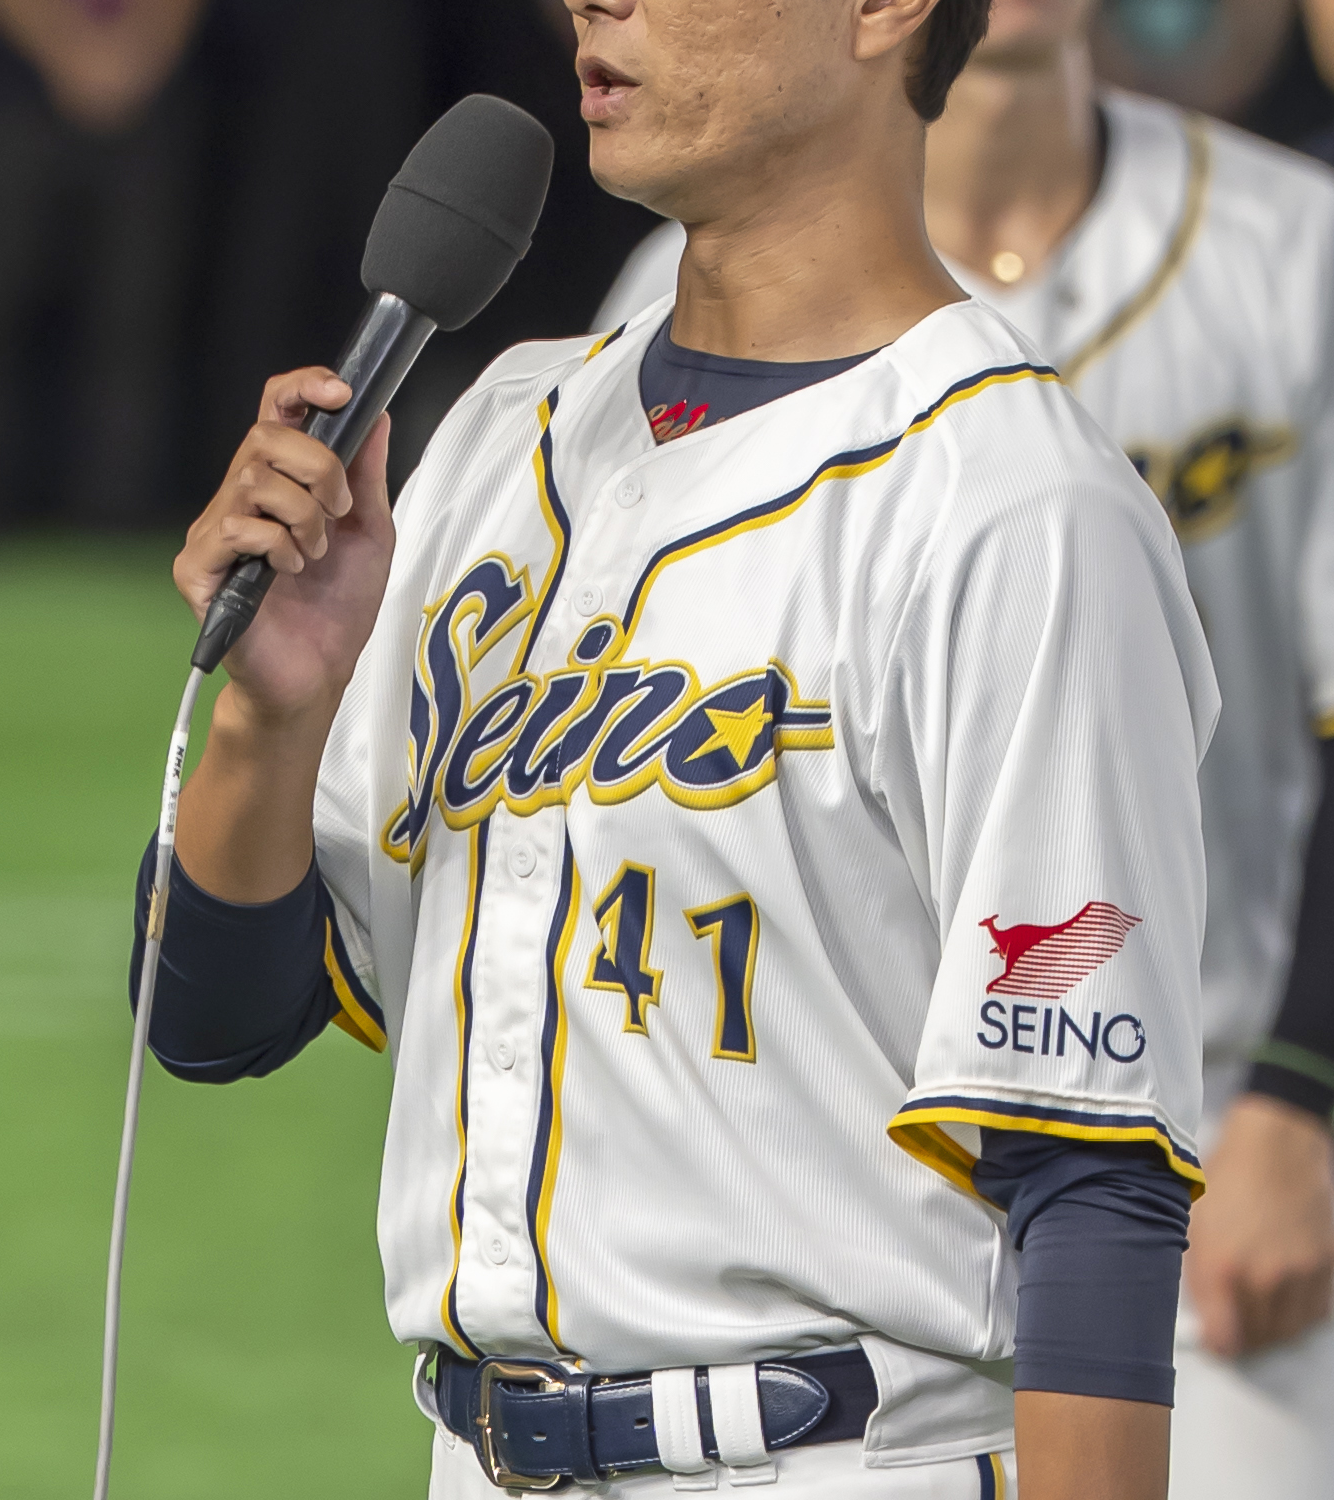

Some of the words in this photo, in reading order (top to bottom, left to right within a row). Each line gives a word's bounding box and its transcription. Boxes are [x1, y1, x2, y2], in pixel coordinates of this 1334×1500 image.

[380, 551, 835, 878] Seino
[584, 860, 760, 1064] 41
[976, 999, 1147, 1064] SEINO
